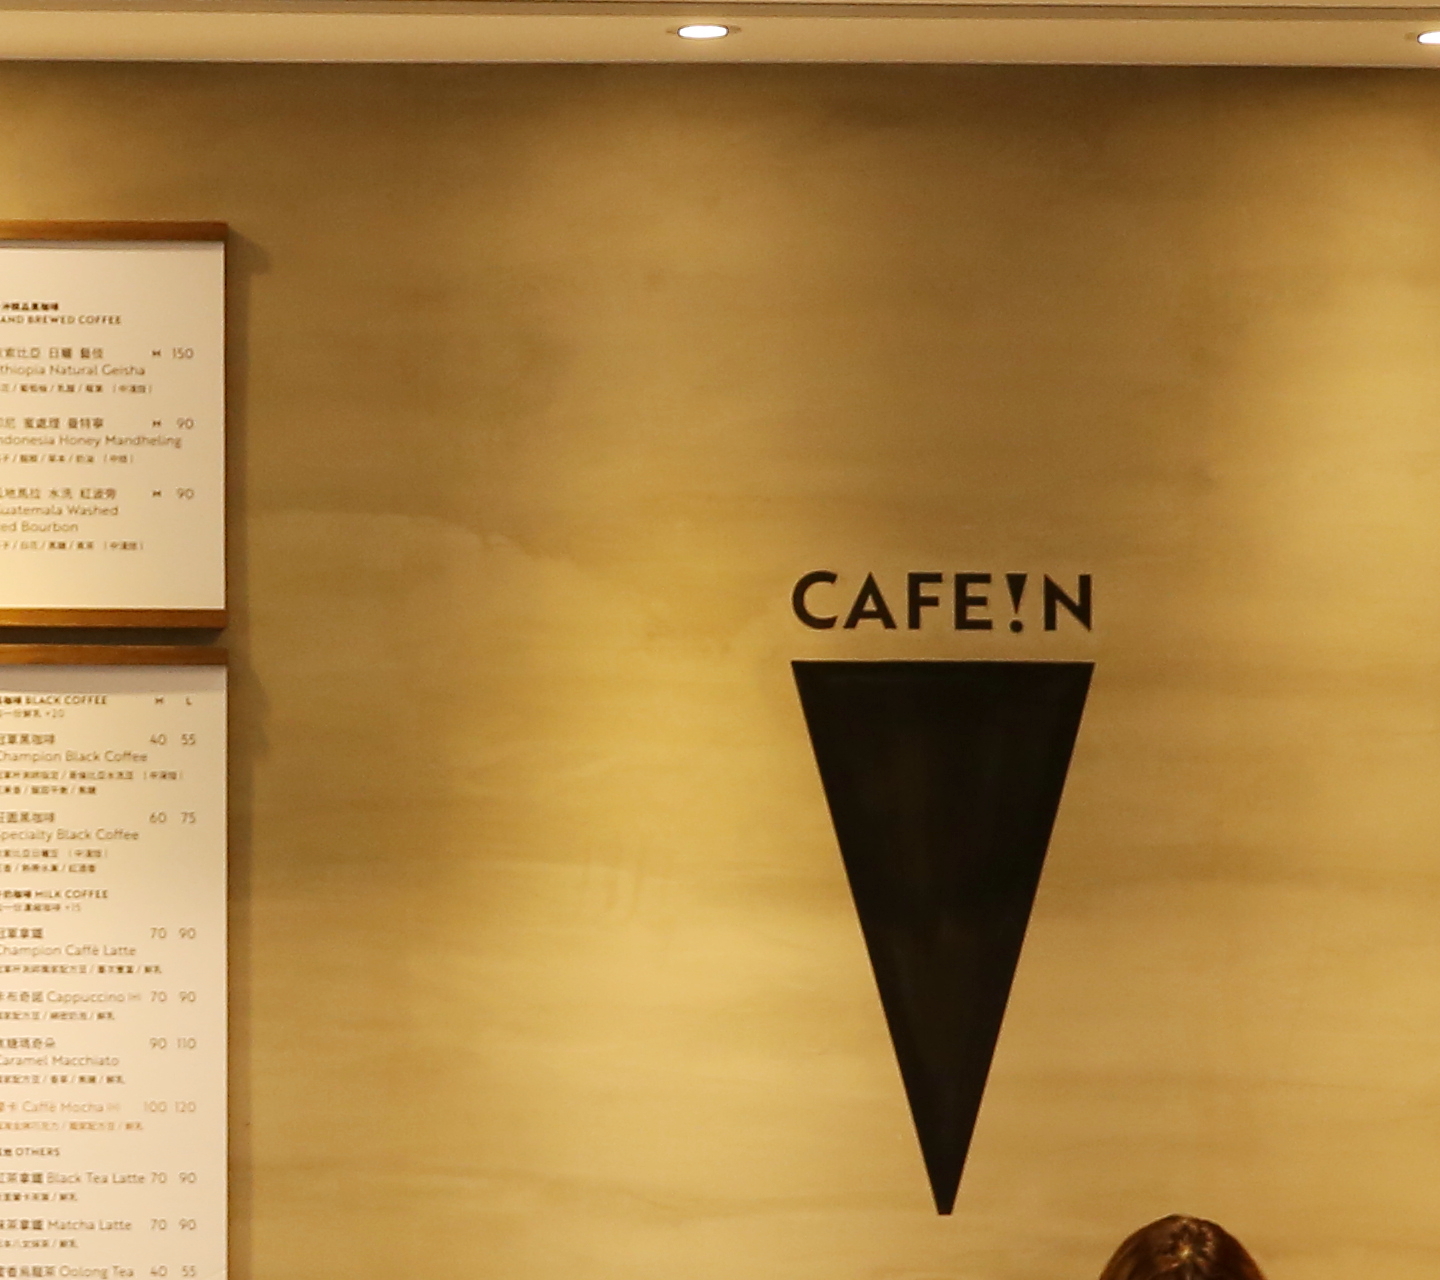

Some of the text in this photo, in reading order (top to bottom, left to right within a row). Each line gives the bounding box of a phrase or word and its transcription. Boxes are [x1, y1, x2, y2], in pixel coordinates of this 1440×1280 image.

[27, 315, 75, 325] BREWED
[78, 315, 122, 325] COFFEE
[173, 349, 194, 359] 150
[50, 364, 98, 374] Natural
[102, 364, 145, 374] Geisha
[176, 419, 194, 429] 90
[59, 435, 100, 448] Honey
[105, 435, 182, 448] Mandheling
[176, 489, 195, 500] 90
[67, 505, 118, 516] Washed
[22, 521, 78, 532] Bourbon
[791, 570, 1095, 634] CAFE!N
[25, 696, 60, 705] BLACK
[64, 696, 107, 705] COFFEE
[150, 733, 167, 745] 40
[181, 733, 196, 745] 55
[65, 751, 99, 760] Black
[104, 751, 148, 760] Coffee
[149, 811, 167, 823] 60
[181, 811, 196, 823] 75
[57, 828, 90, 840] Black
[95, 828, 140, 840] Coffee
[64, 890, 108, 899] COFFEE
[150, 928, 167, 939] 70
[179, 928, 196, 939] 90
[104, 944, 137, 954] Latte
[47, 991, 125, 1003] Cappuccino
[150, 991, 167, 1003] 70
[179, 991, 196, 1003] 90
[149, 1037, 167, 1049] 90
[176, 1037, 196, 1049] 110
[52, 1054, 120, 1066] Macchiato
[60, 1101, 104, 1113] Mocha
[144, 1101, 167, 1113] 100
[175, 1101, 196, 1113] 120
[15, 1147, 60, 1156] OTHERS
[47, 1172, 80, 1184] Black
[87, 1172, 108, 1184] Tea
[112, 1172, 145, 1184] Latte
[151, 1172, 167, 1184] 70
[179, 1172, 197, 1184] 90
[48, 1219, 95, 1231] Matcha
[99, 1219, 133, 1231] Latte
[150, 1219, 167, 1231] 70
[179, 1219, 196, 1231] 90
[59, 1265, 108, 1279] Oolong
[112, 1265, 135, 1276] Tea
[150, 1265, 168, 1276] 40
[182, 1265, 197, 1276] 55
